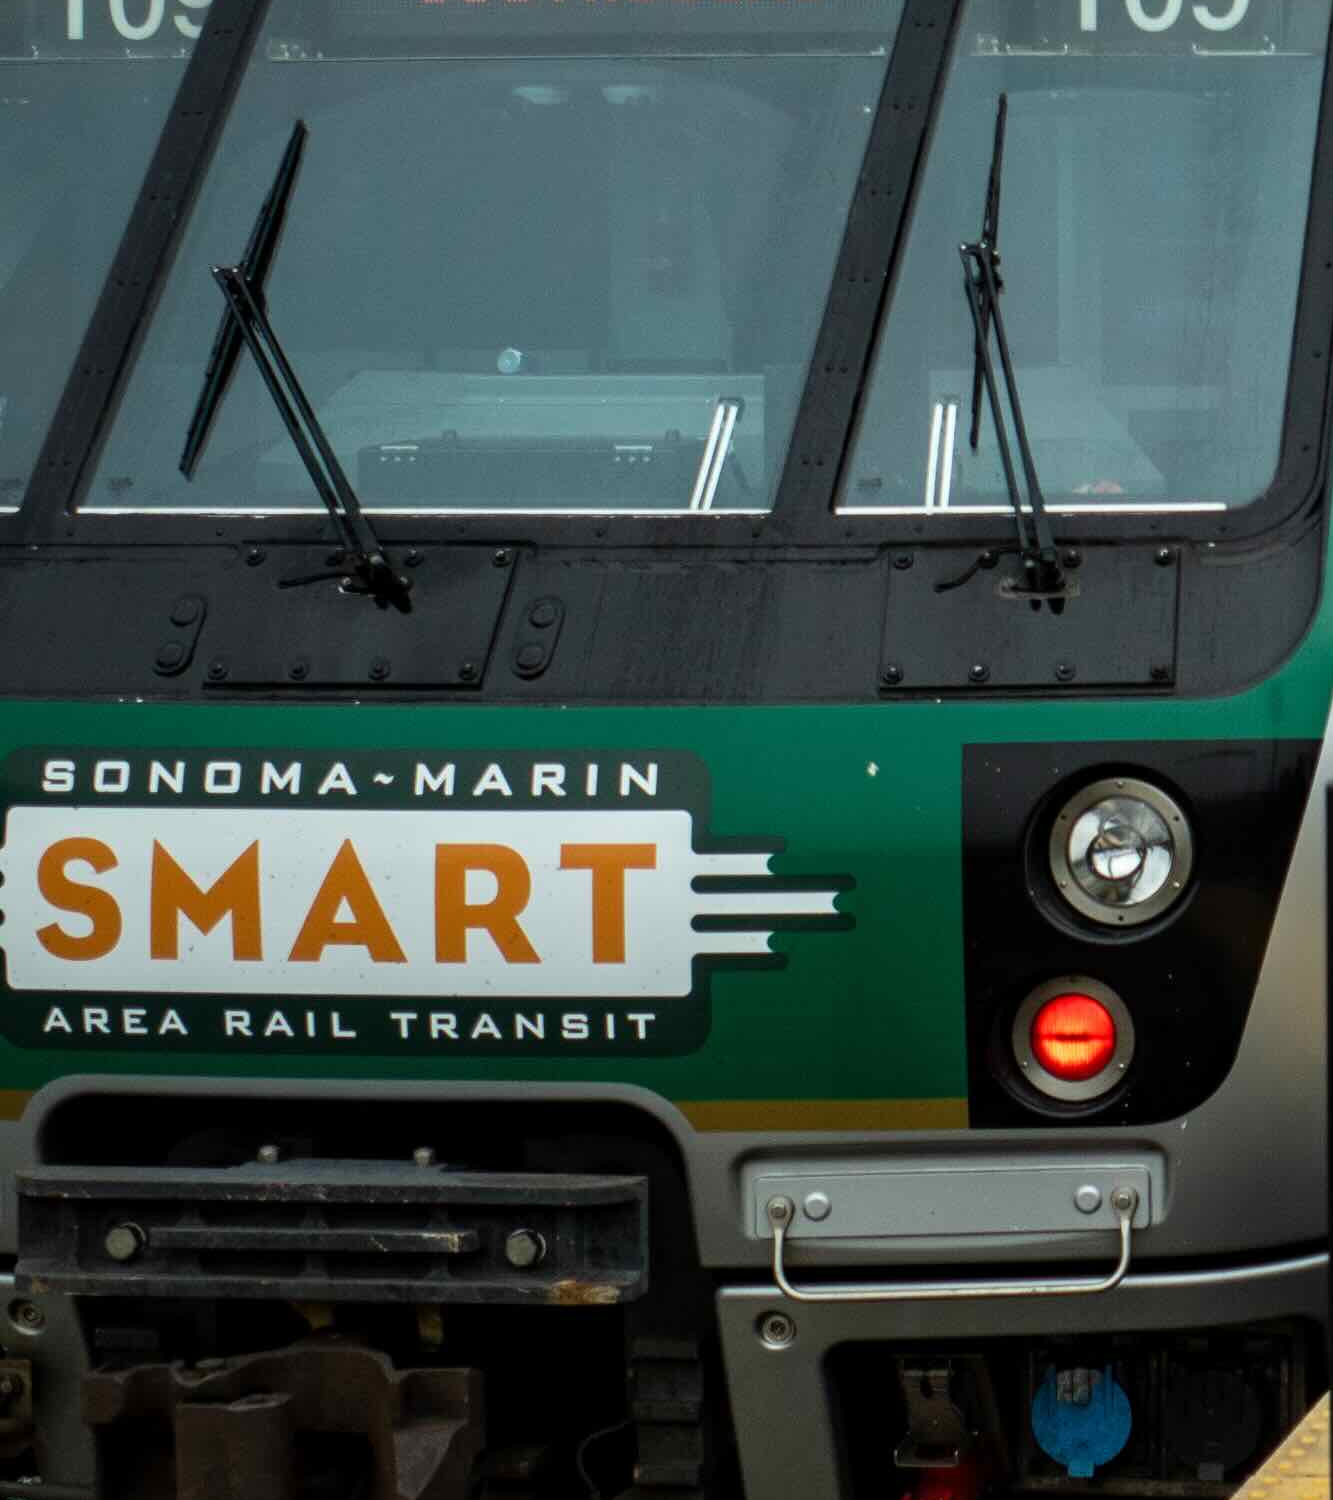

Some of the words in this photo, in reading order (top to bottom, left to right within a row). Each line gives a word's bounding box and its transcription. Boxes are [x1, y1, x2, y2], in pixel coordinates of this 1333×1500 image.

[34, 836, 659, 966] SMART
[43, 1007, 190, 1037] AREA
[224, 1009, 358, 1039] RAIL
[390, 1011, 659, 1042] TRANSIT
